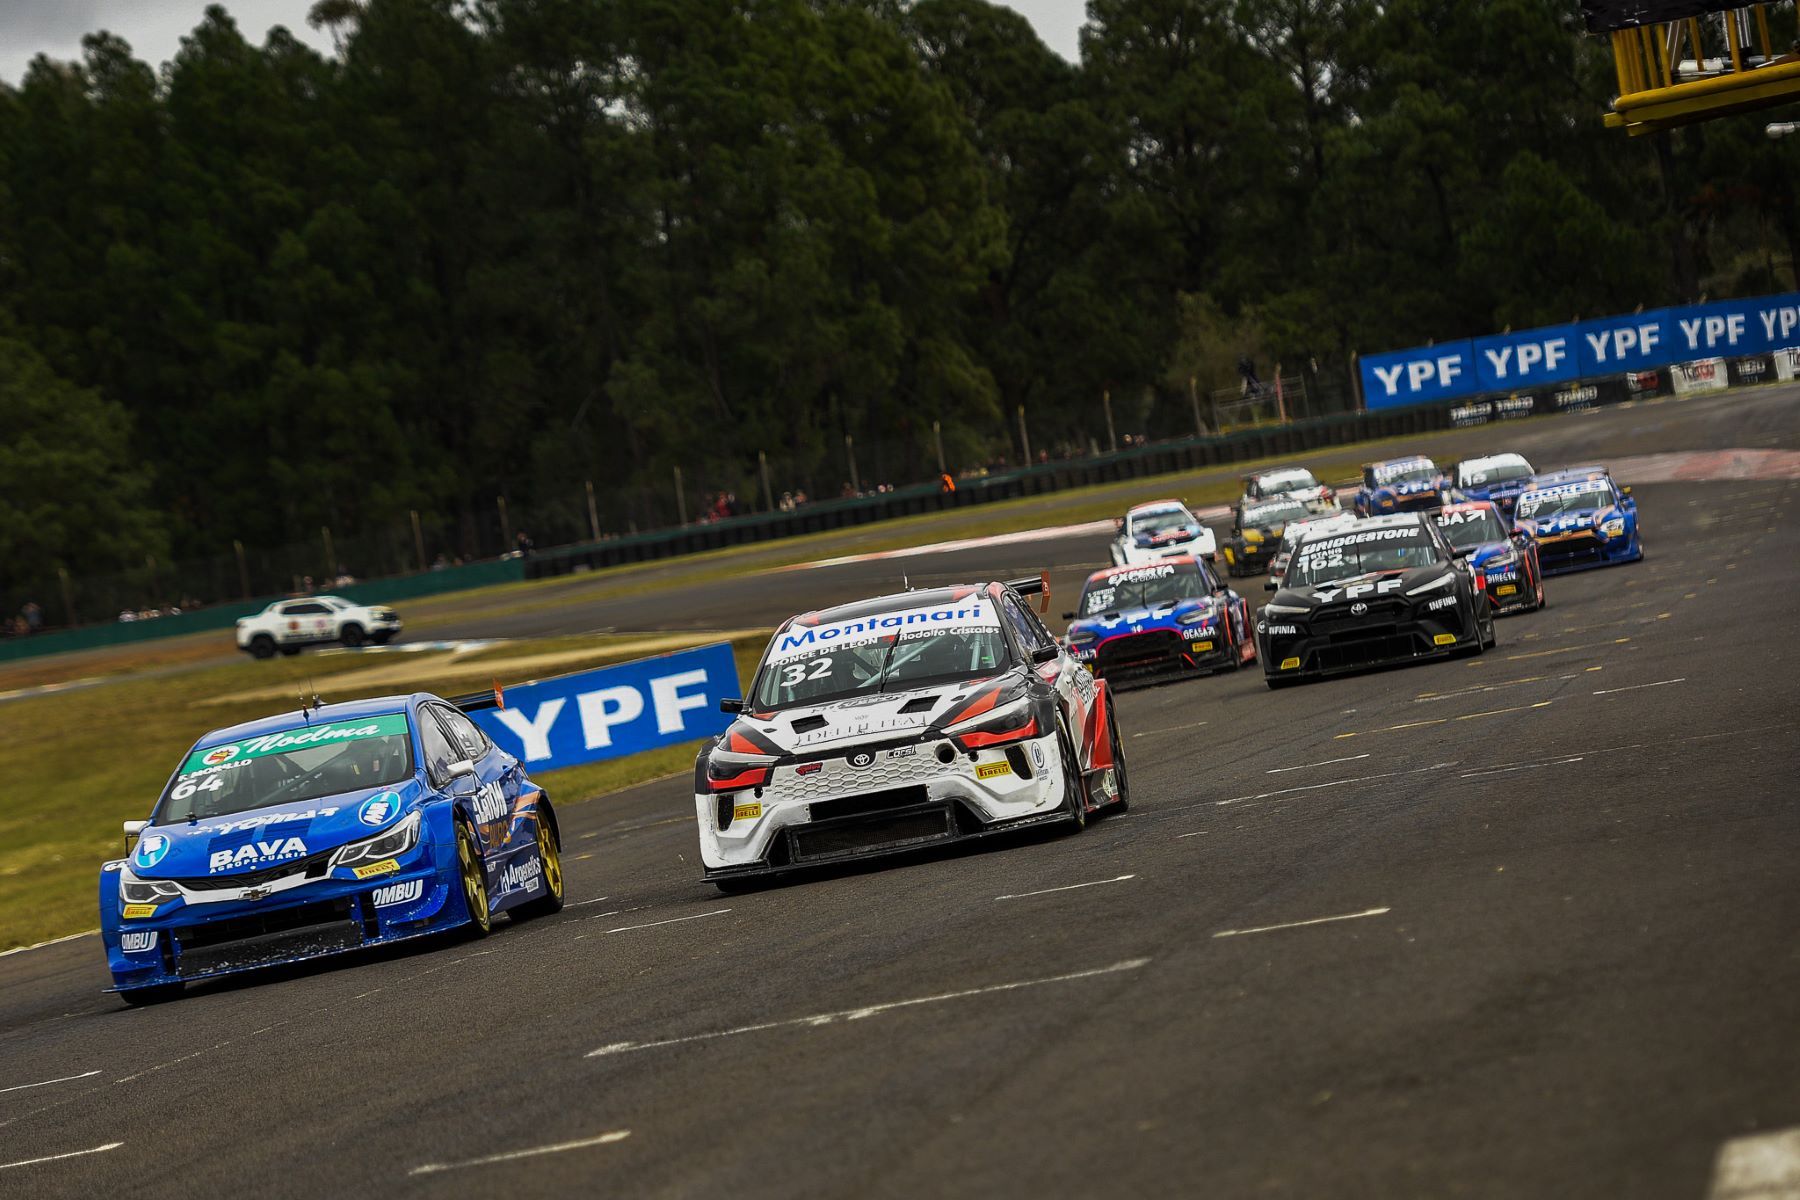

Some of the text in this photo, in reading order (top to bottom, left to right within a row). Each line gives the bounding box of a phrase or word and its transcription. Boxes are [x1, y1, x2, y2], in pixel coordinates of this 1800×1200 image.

[1679, 313, 1746, 349] YPF
[1760, 306, 1800, 342] YP
[1586, 323, 1660, 363] YPF
[1485, 338, 1567, 379] YPF
[1373, 354, 1462, 396] YPF
[1538, 517, 1592, 533] YPF
[1301, 527, 1420, 556] BRIDGESTONE
[1297, 552, 1345, 575] 162
[1312, 578, 1403, 603] YPF
[1428, 596, 1457, 612] INFINIA
[780, 604, 982, 652] Montanari
[900, 626, 1000, 642] Rodolfo Cristales
[770, 637, 878, 670] PONCE DE LEON
[780, 656, 833, 688] 32
[493, 668, 708, 762] YPF
[243, 723, 380, 753] Noelma
[190, 759, 253, 779] MORILLO
[978, 763, 1009, 777] PIRELLI
[170, 774, 224, 800] 64
[735, 804, 760, 819] PIRELLI
[209, 837, 308, 868] BAVA
[209, 850, 308, 874] AGROPECUARIA
[358, 862, 397, 879] PIRELLI
[371, 879, 425, 908] OMBU
[121, 931, 158, 954] OMBU
